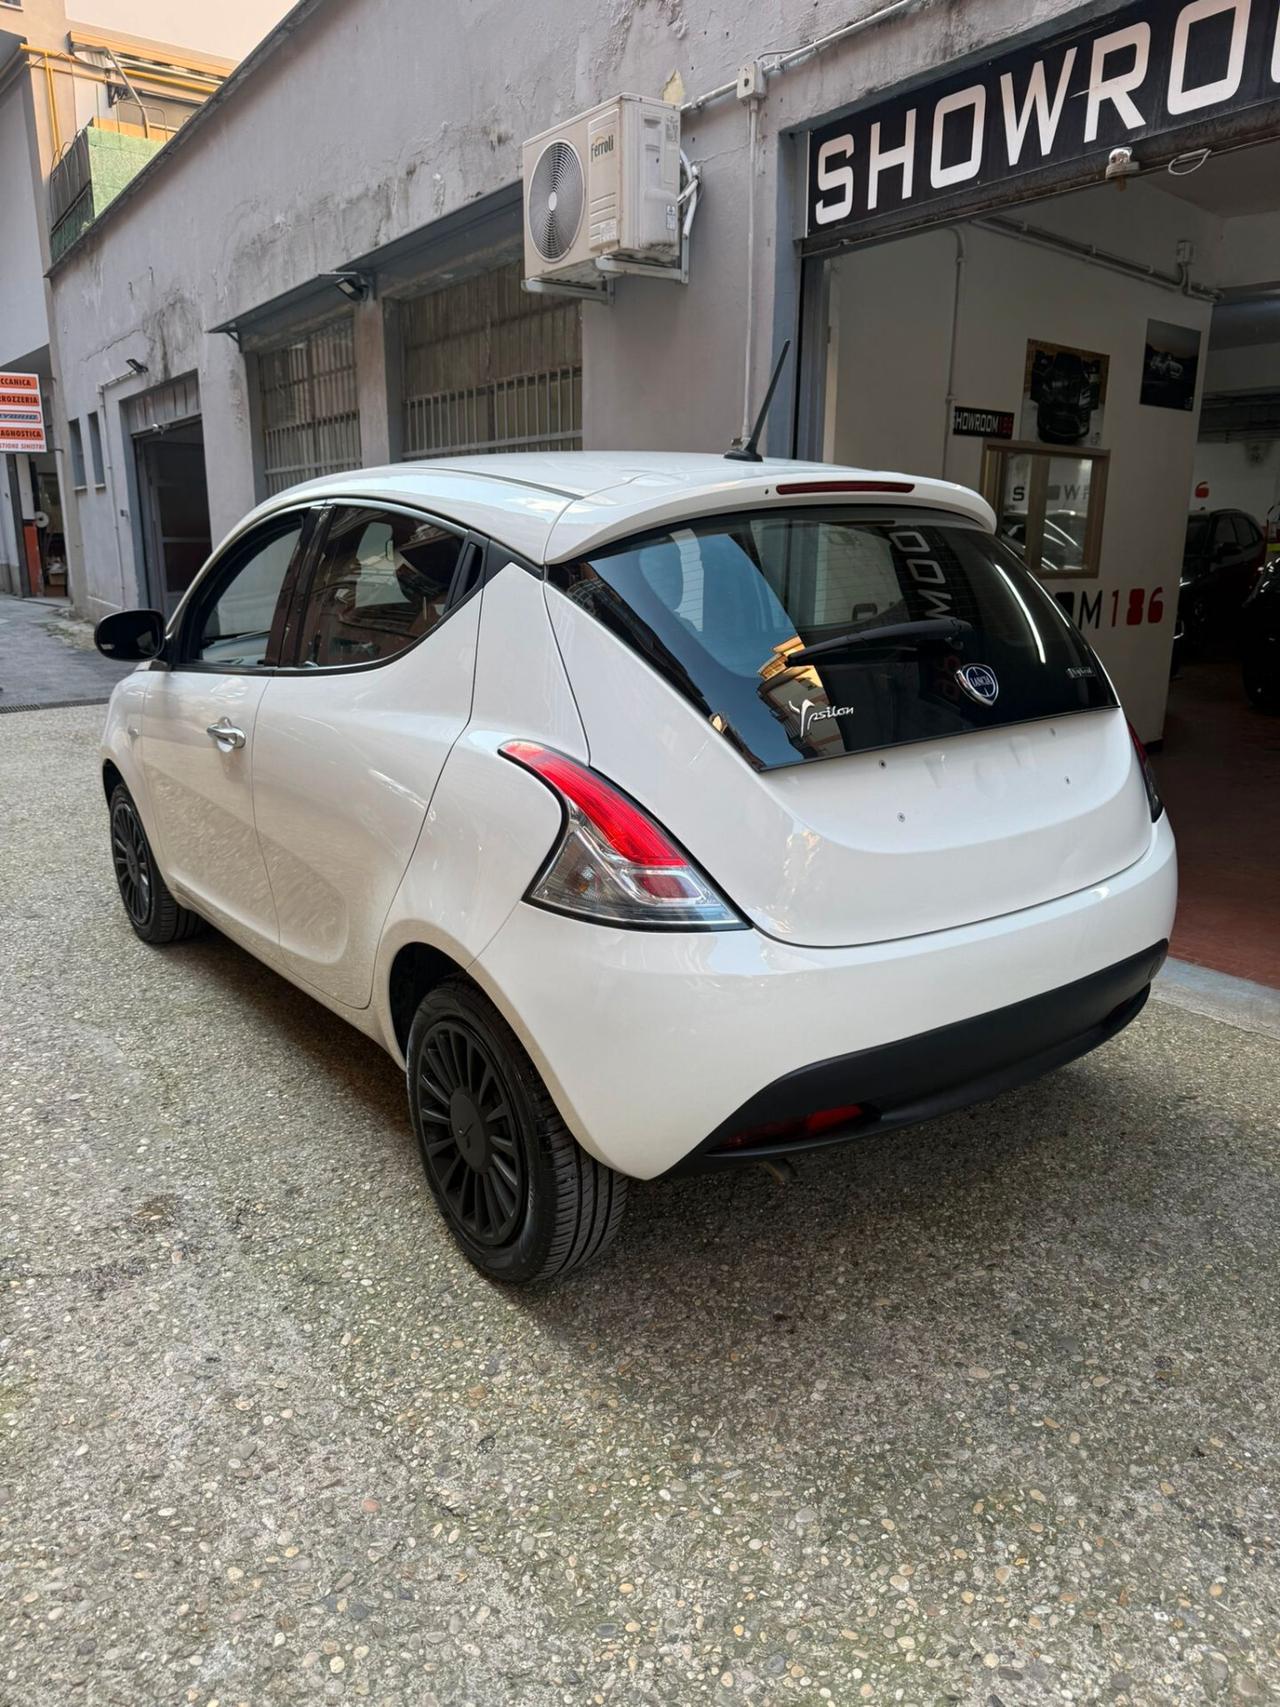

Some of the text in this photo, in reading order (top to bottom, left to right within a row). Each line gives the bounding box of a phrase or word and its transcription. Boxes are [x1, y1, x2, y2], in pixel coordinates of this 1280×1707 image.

[815, 0, 1280, 225] SHOWRO
[0, 395, 38, 404] ROZZERIA
[788, 699, 854, 738] Ypsilon
